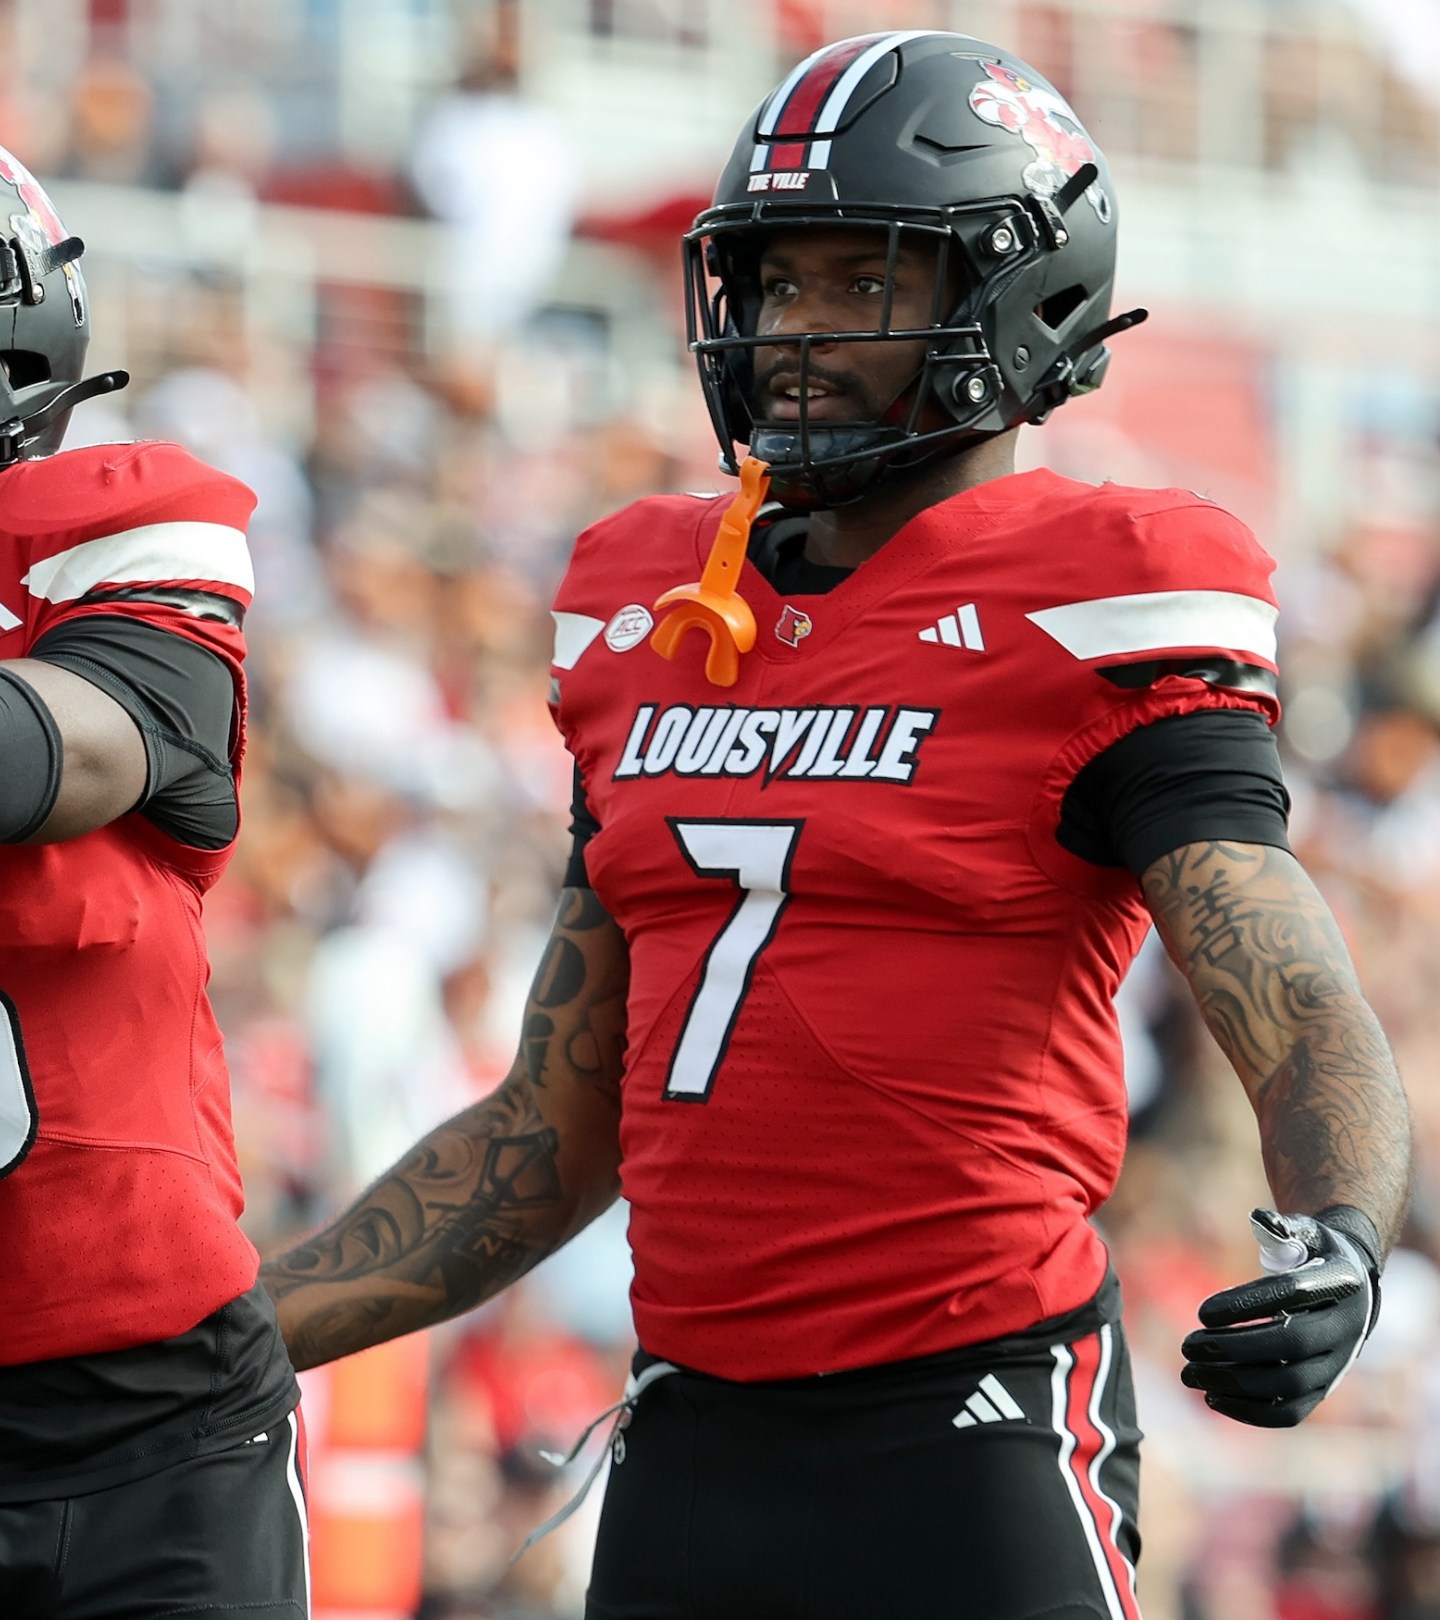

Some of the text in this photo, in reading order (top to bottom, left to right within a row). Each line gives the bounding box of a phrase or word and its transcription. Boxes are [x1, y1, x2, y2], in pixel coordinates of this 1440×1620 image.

[772, 172, 811, 190] VILLE
[613, 703, 940, 785] LOUISVILLE
[665, 818, 806, 1103] 7
